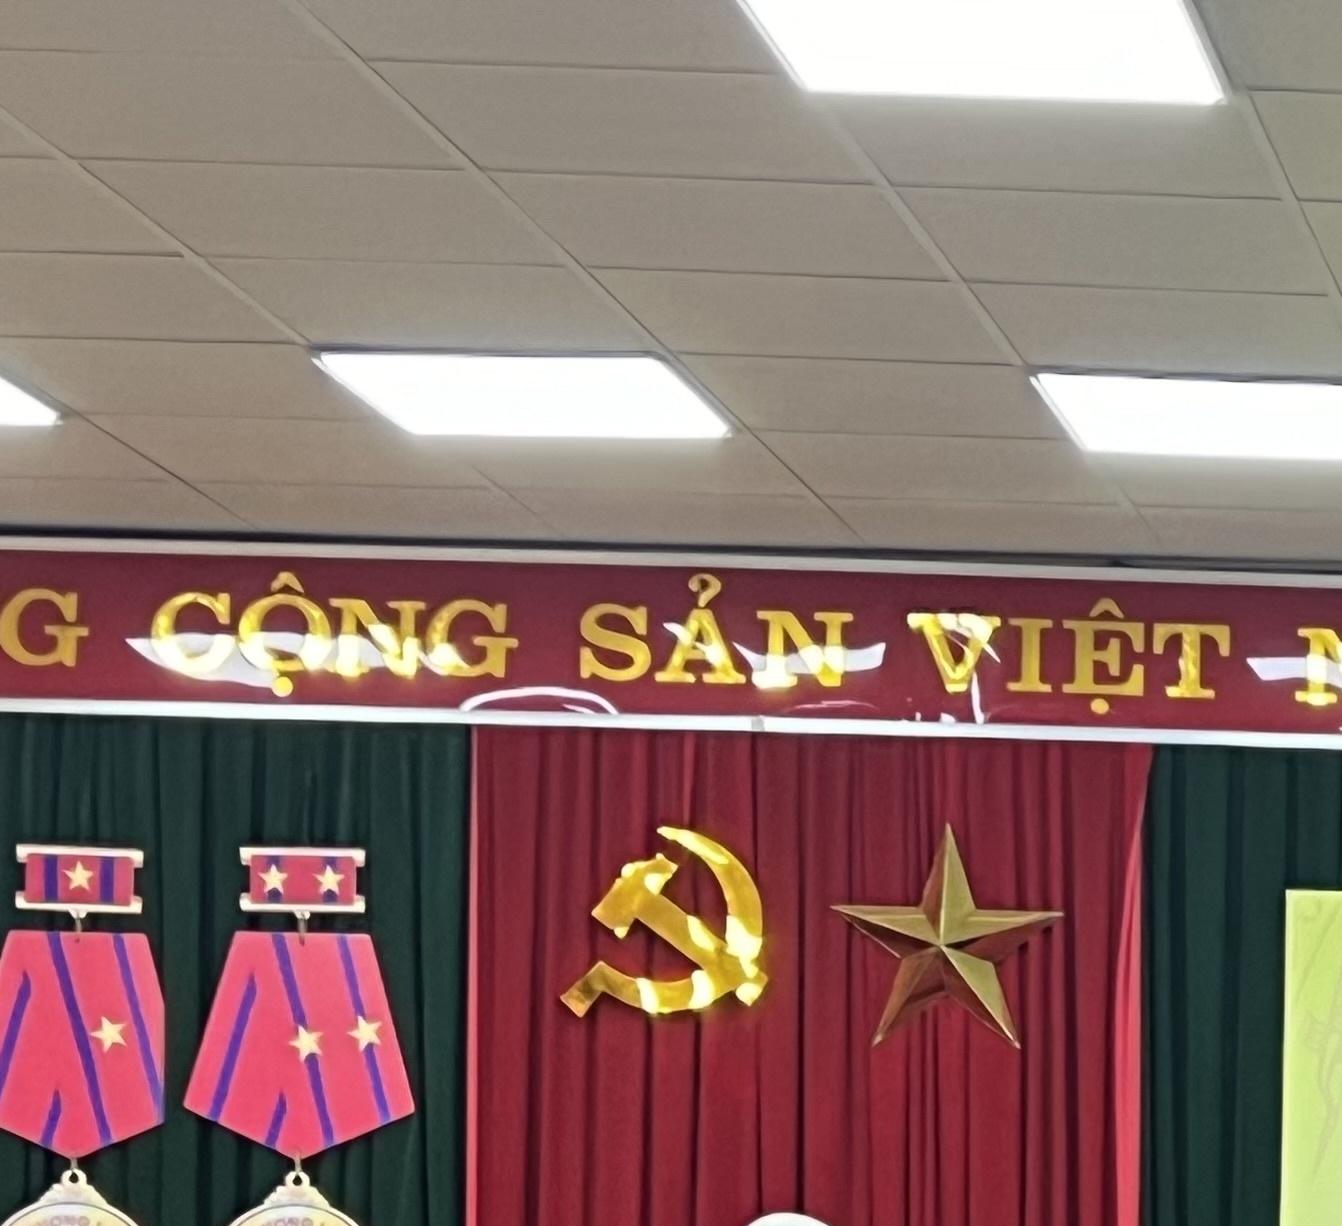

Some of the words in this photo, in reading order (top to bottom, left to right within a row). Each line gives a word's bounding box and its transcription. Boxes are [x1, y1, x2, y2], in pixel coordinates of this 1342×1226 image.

[150, 571, 519, 698] CỘNG
[579, 573, 854, 690] SẢN
[907, 598, 1230, 715] VIỆT
